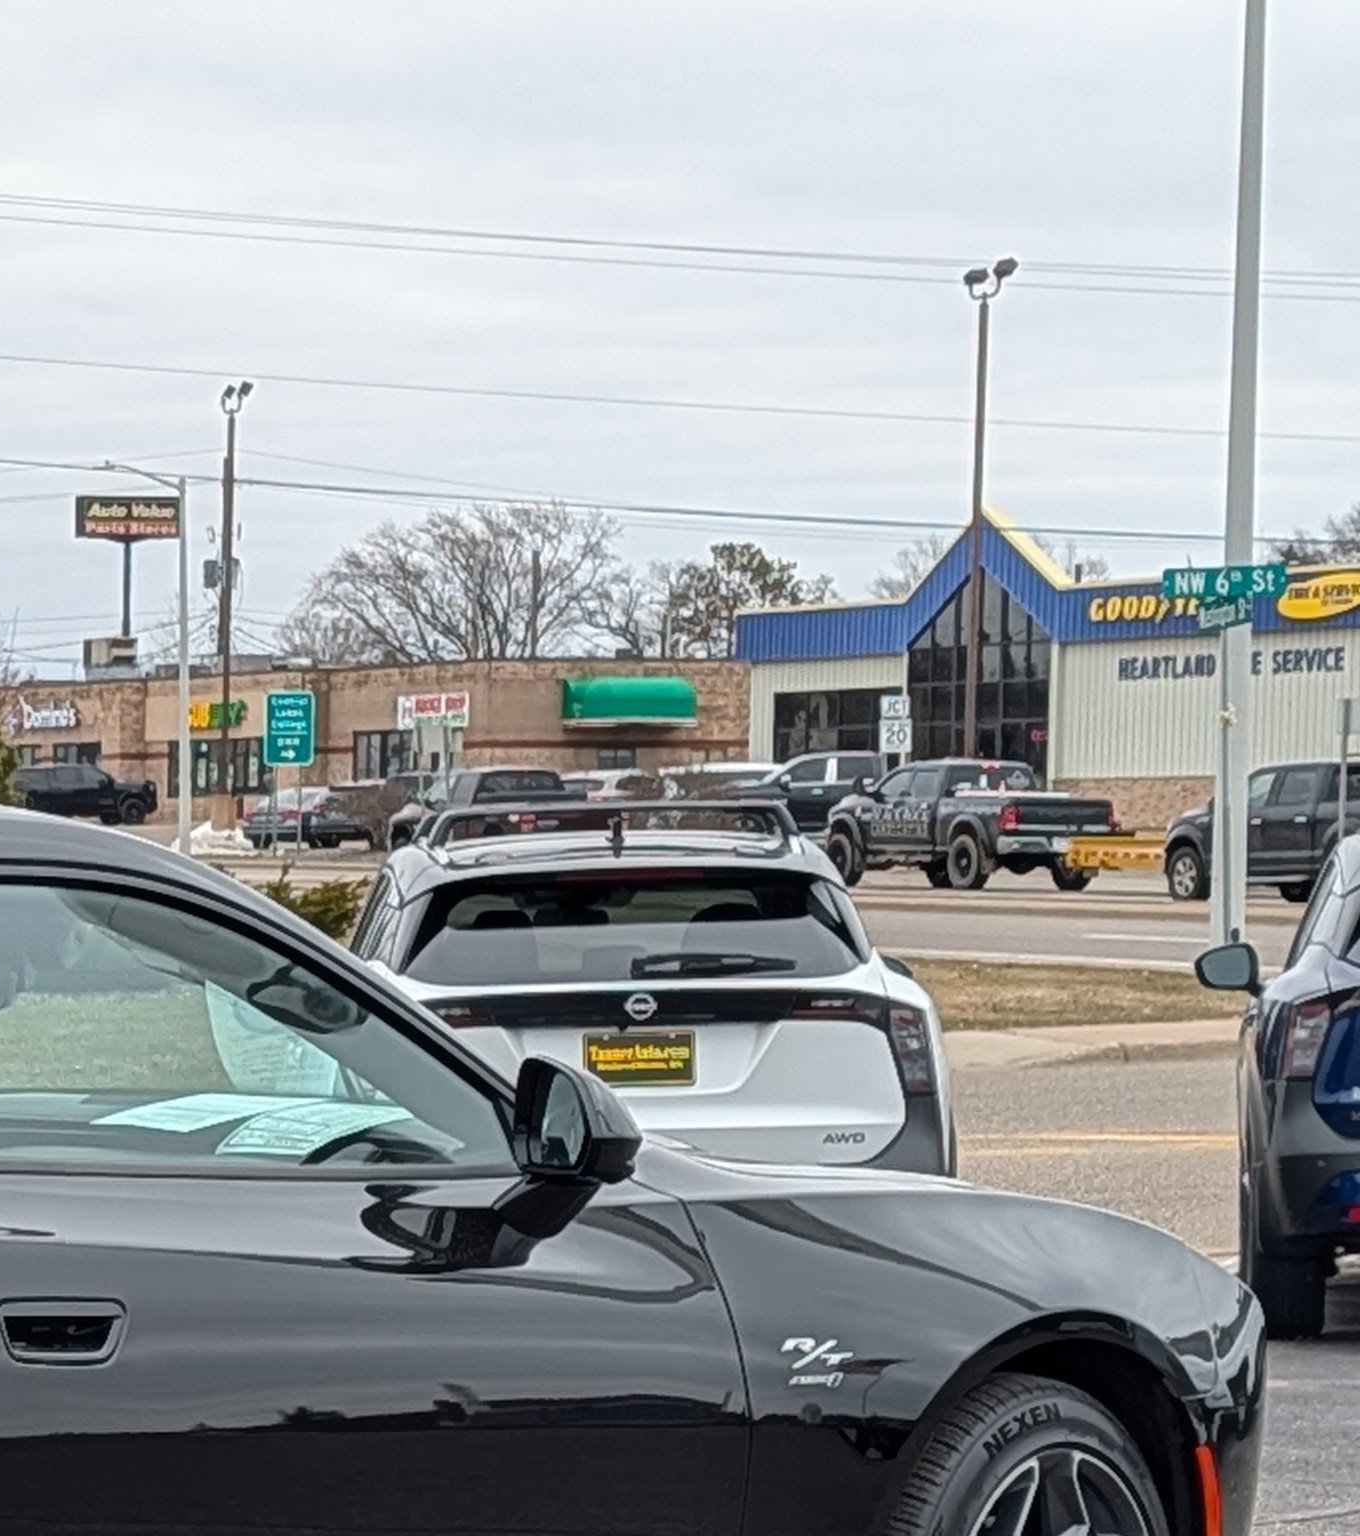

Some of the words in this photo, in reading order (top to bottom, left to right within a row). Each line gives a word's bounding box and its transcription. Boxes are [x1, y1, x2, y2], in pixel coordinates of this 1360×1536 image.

[86, 501, 128, 518] Auto
[131, 501, 175, 518] Value
[1174, 571, 1206, 595] NW
[1215, 569, 1243, 596] 6th
[1252, 569, 1276, 593] St
[1117, 653, 1217, 681] HEARTLAND
[1272, 646, 1346, 675] SERVICE
[885, 699, 908, 715] JCT
[885, 728, 908, 745] 20
[822, 1132, 865, 1144] AWD
[780, 1337, 854, 1370] R/T
[982, 1402, 1062, 1460] NEXEN
